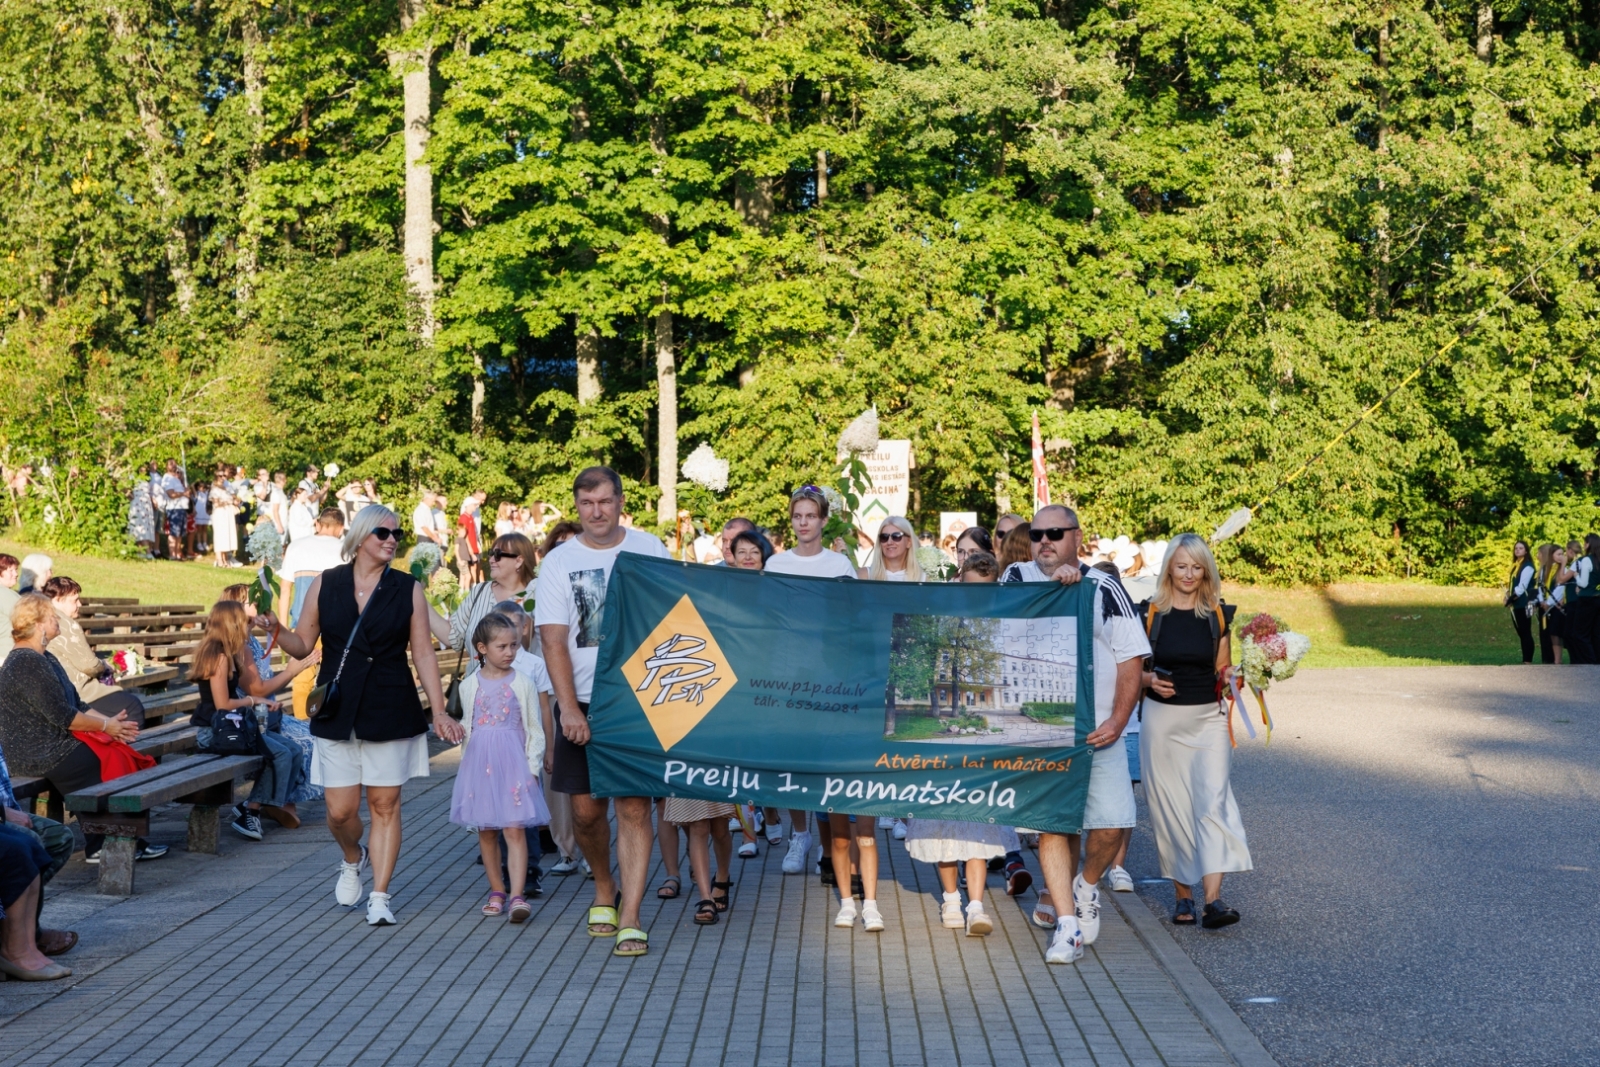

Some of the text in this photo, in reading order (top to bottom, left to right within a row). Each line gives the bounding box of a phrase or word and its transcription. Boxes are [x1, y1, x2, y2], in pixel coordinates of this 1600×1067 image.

[749, 678, 868, 698] www.p1p.edu.lv
[753, 694, 860, 714] tālr. 65322084
[961, 755, 986, 769] lai
[992, 757, 1073, 772] mācītos!
[663, 760, 1017, 809] Preiļu 1. pamatskola
